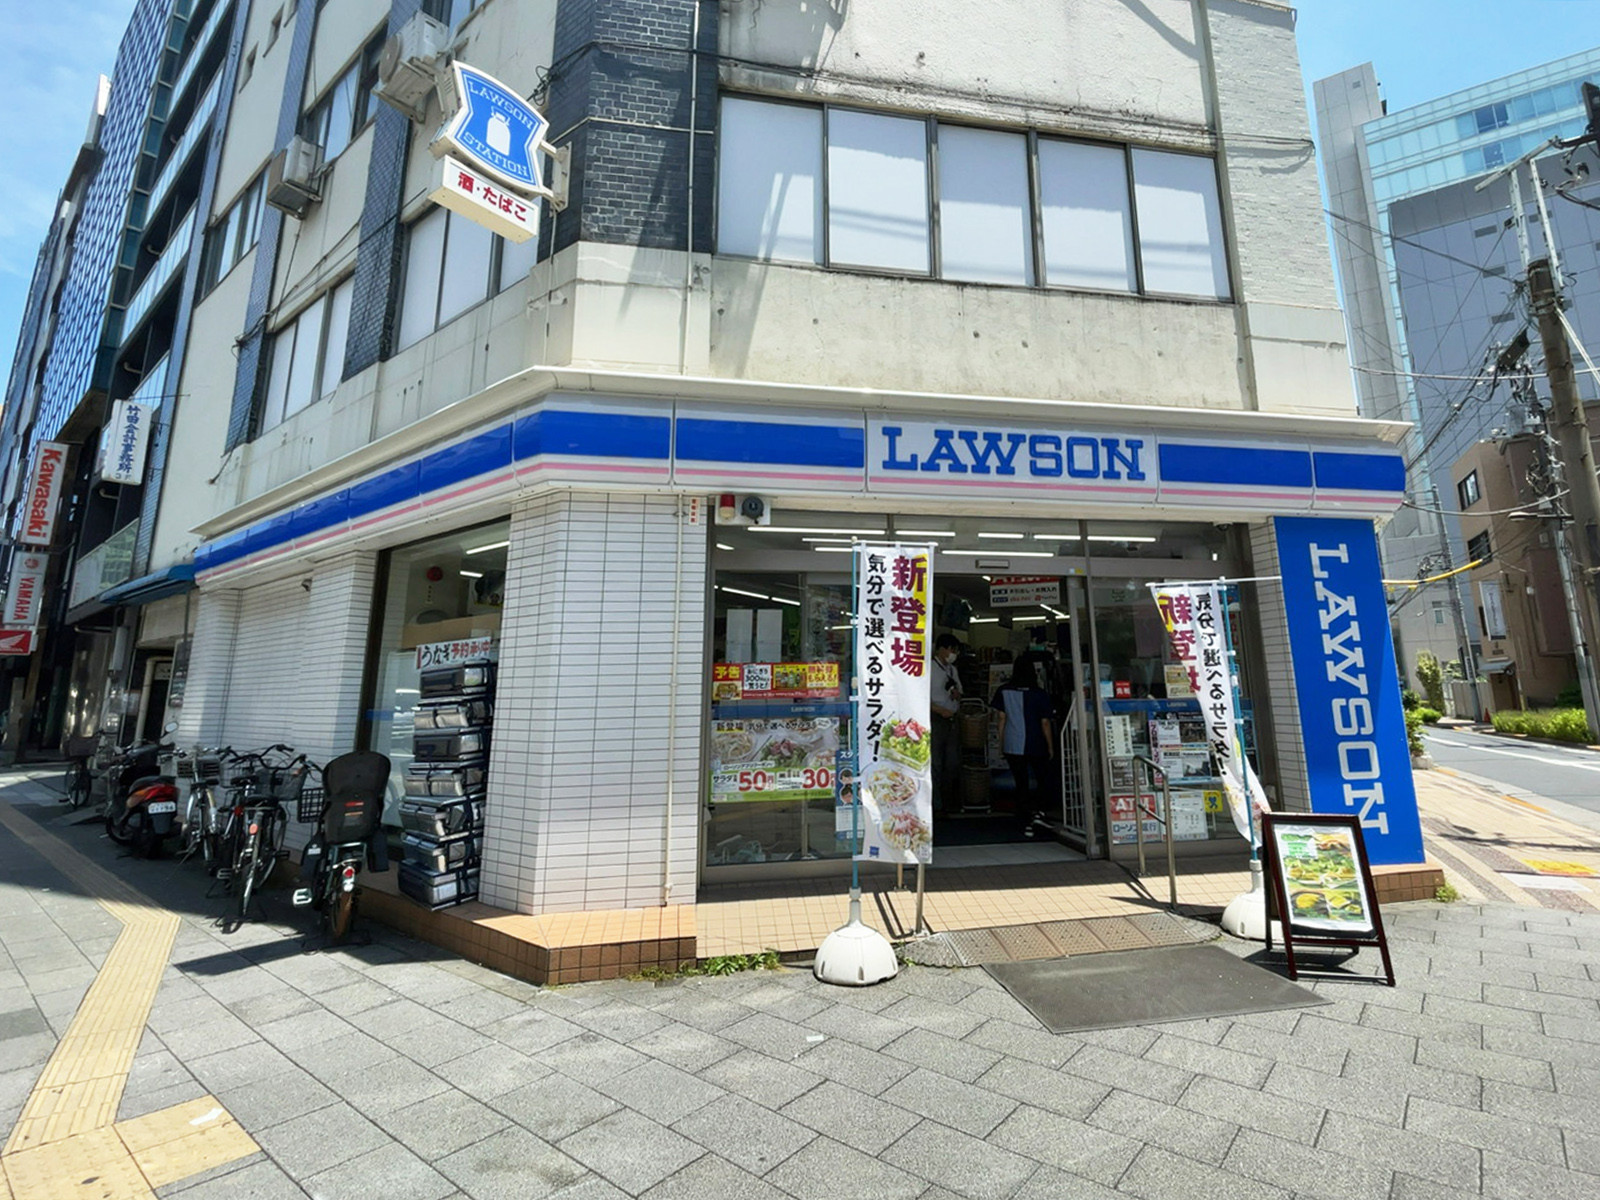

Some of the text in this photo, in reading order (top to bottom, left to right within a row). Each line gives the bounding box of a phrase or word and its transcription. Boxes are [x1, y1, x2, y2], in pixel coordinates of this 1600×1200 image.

[468, 80, 533, 130] LAWSON
[463, 131, 529, 177] STATION
[458, 172, 527, 222] 酒・たばこ
[881, 425, 1145, 480] LAWSON
[27, 448, 62, 538] Kawasaki
[13, 576, 36, 621] YAMAHA
[890, 554, 927, 678] 新登場
[714, 665, 741, 679] 予告
[1309, 542, 1390, 835] LAWSON
